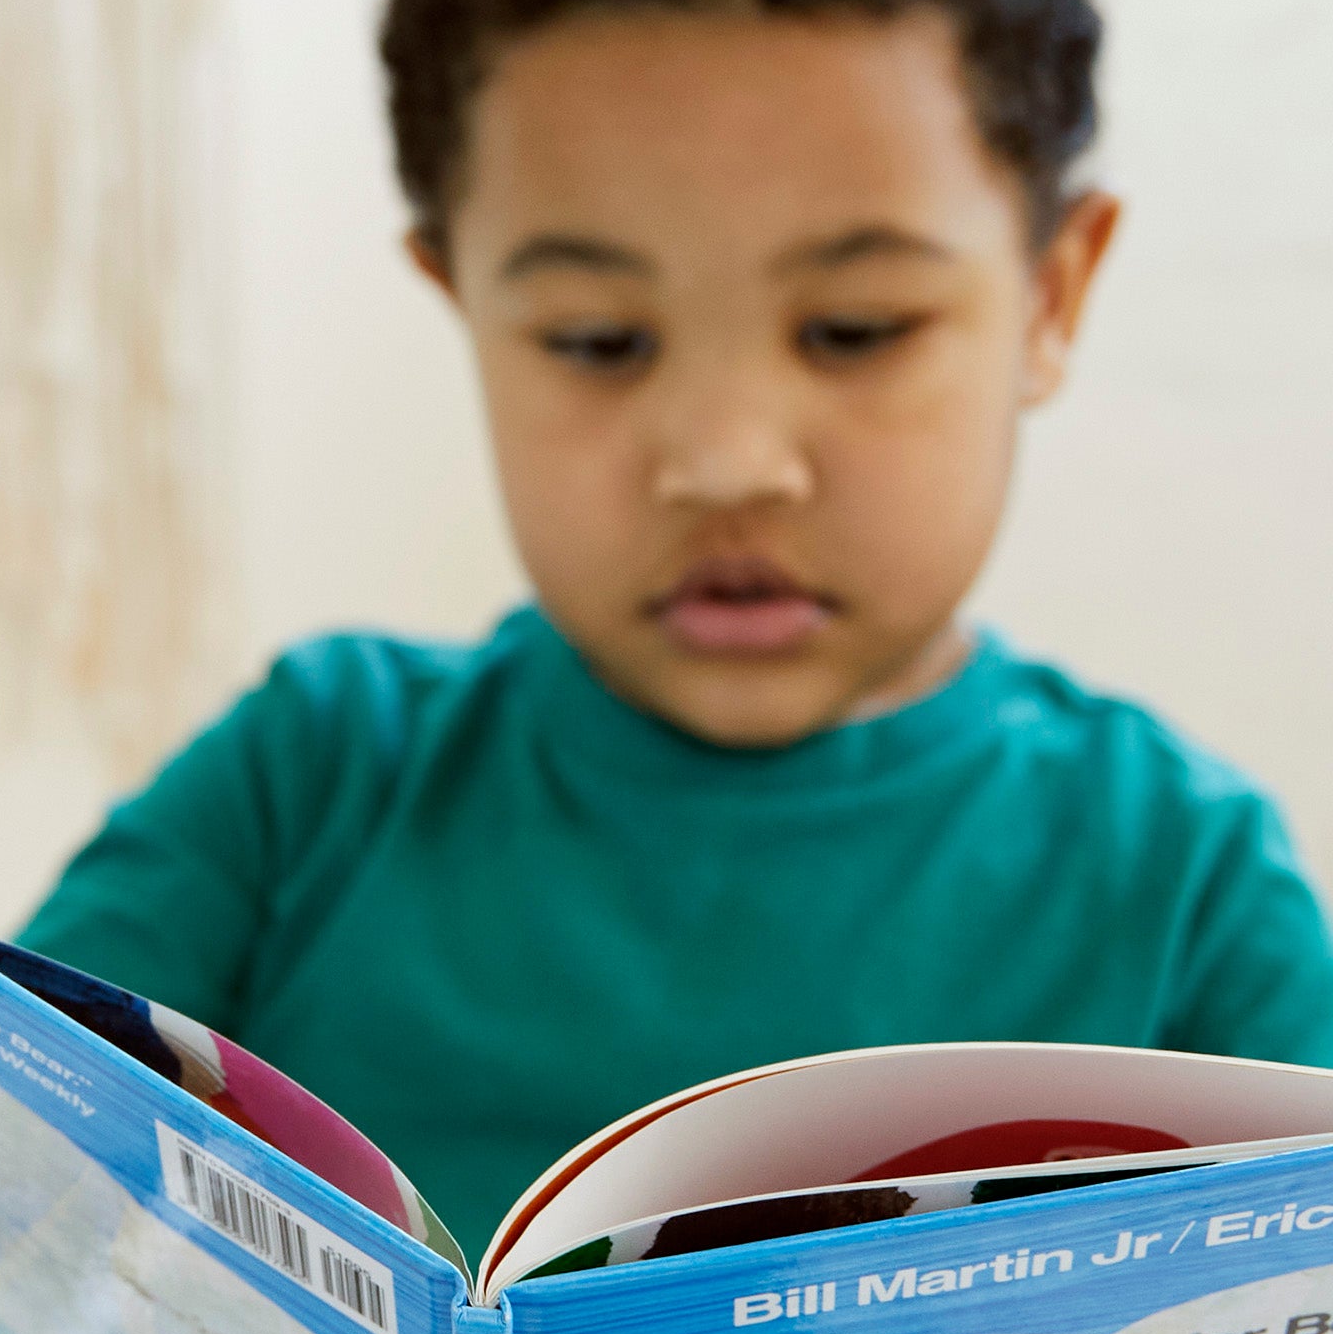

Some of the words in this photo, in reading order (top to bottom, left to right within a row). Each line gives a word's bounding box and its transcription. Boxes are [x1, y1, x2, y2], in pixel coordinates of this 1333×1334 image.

[733, 1281, 835, 1327] Bill
[858, 1248, 1073, 1306] Martin
[1091, 1231, 1162, 1266] Jr
[1205, 1203, 1333, 1247] Eric
